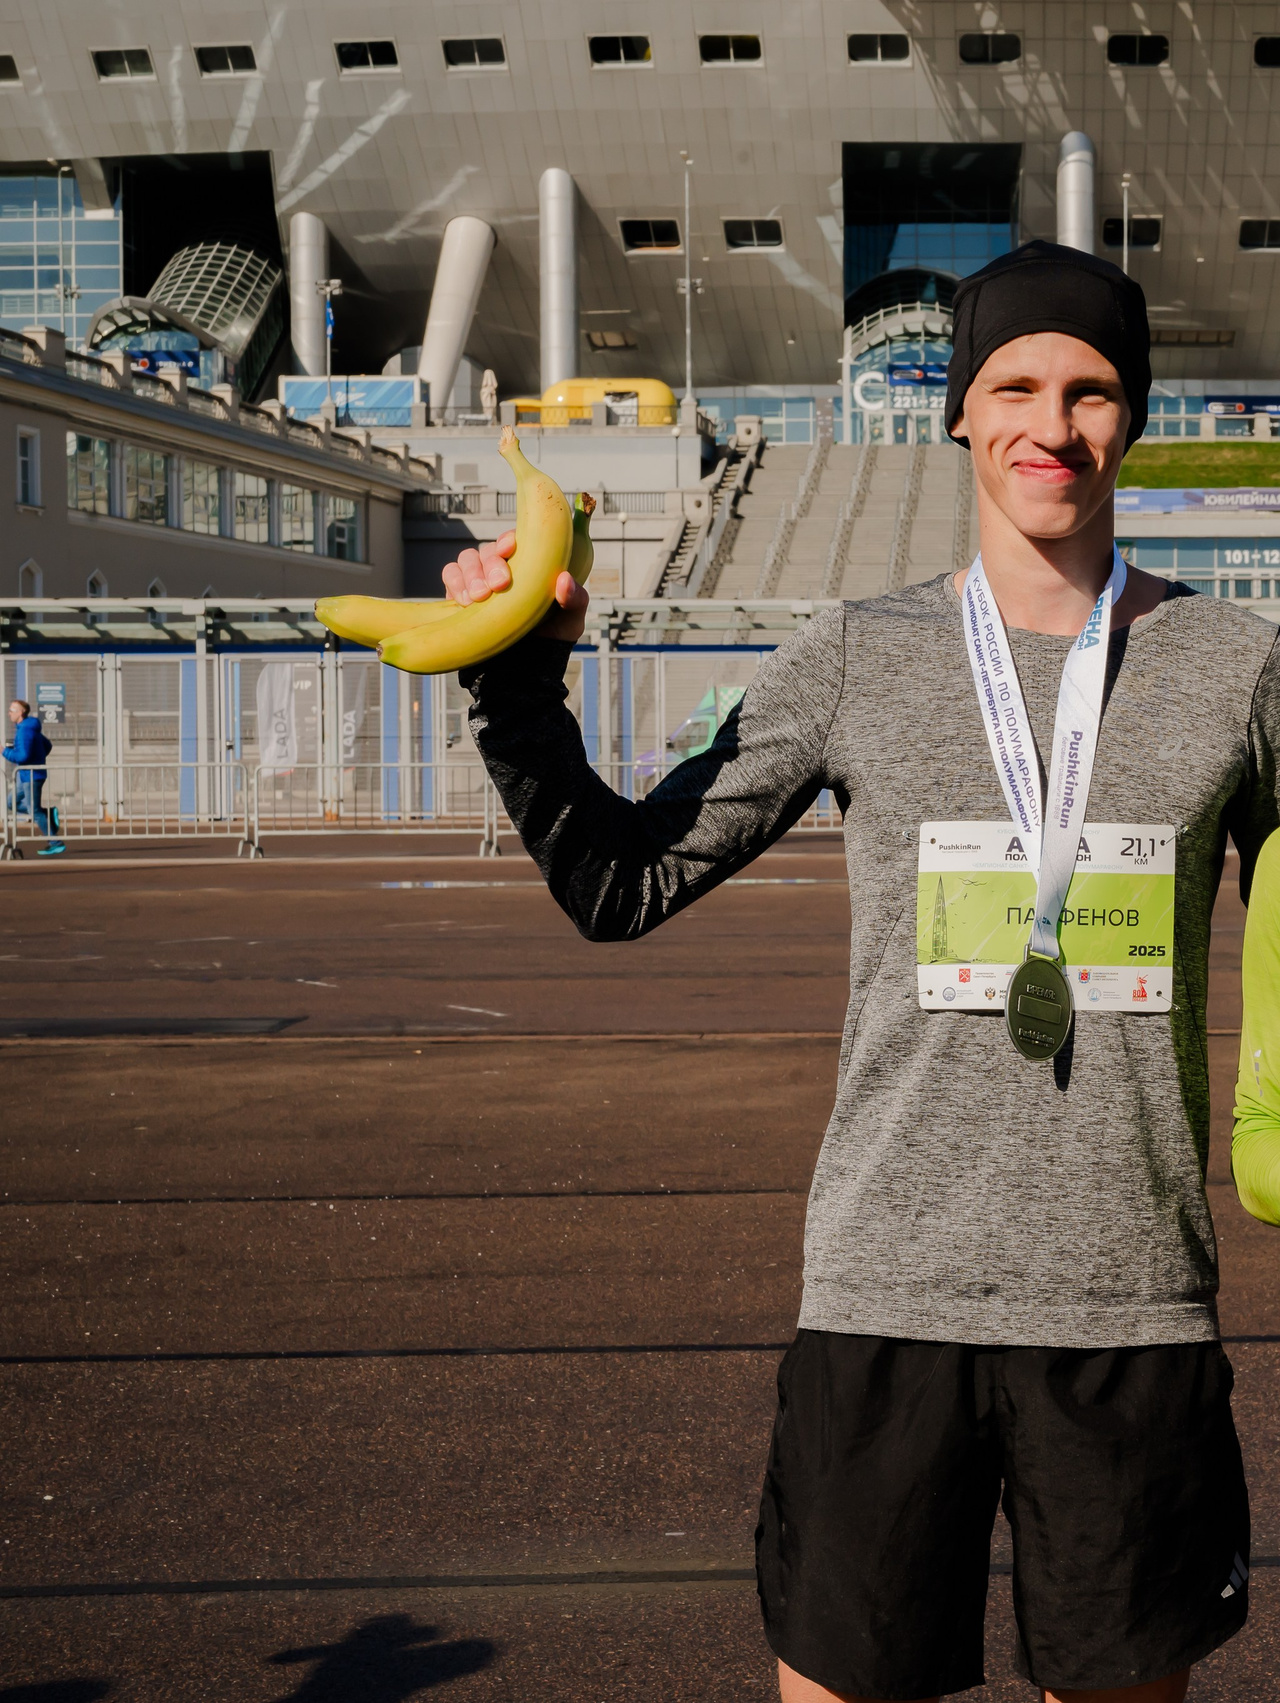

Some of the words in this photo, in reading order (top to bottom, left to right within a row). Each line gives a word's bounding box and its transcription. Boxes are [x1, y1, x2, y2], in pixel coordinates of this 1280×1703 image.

[966, 585, 980, 637] ЧЕМПИОНАТ
[973, 576, 990, 620] КУБОК
[1084, 596, 1104, 649] РЕНА
[984, 623, 1004, 677] РОССИИ
[293, 680, 312, 690] VIP
[973, 638, 1001, 730] САНКТ-ПЕТЕРБУРГА
[998, 682, 1011, 702] ПО
[274, 708, 289, 759] LADA
[343, 710, 356, 759] LADA
[995, 730, 1004, 745] ПО
[999, 745, 1033, 834] ПОЛУМАРАФОНУ
[1004, 707, 1041, 827] ПОЛУМАРАФОНУ
[1060, 730, 1083, 829] PushkinRun
[1120, 837, 1155, 858] 21,1
[1007, 907, 1140, 926] ПАФЕНОВ
[1128, 945, 1166, 957] 2025
